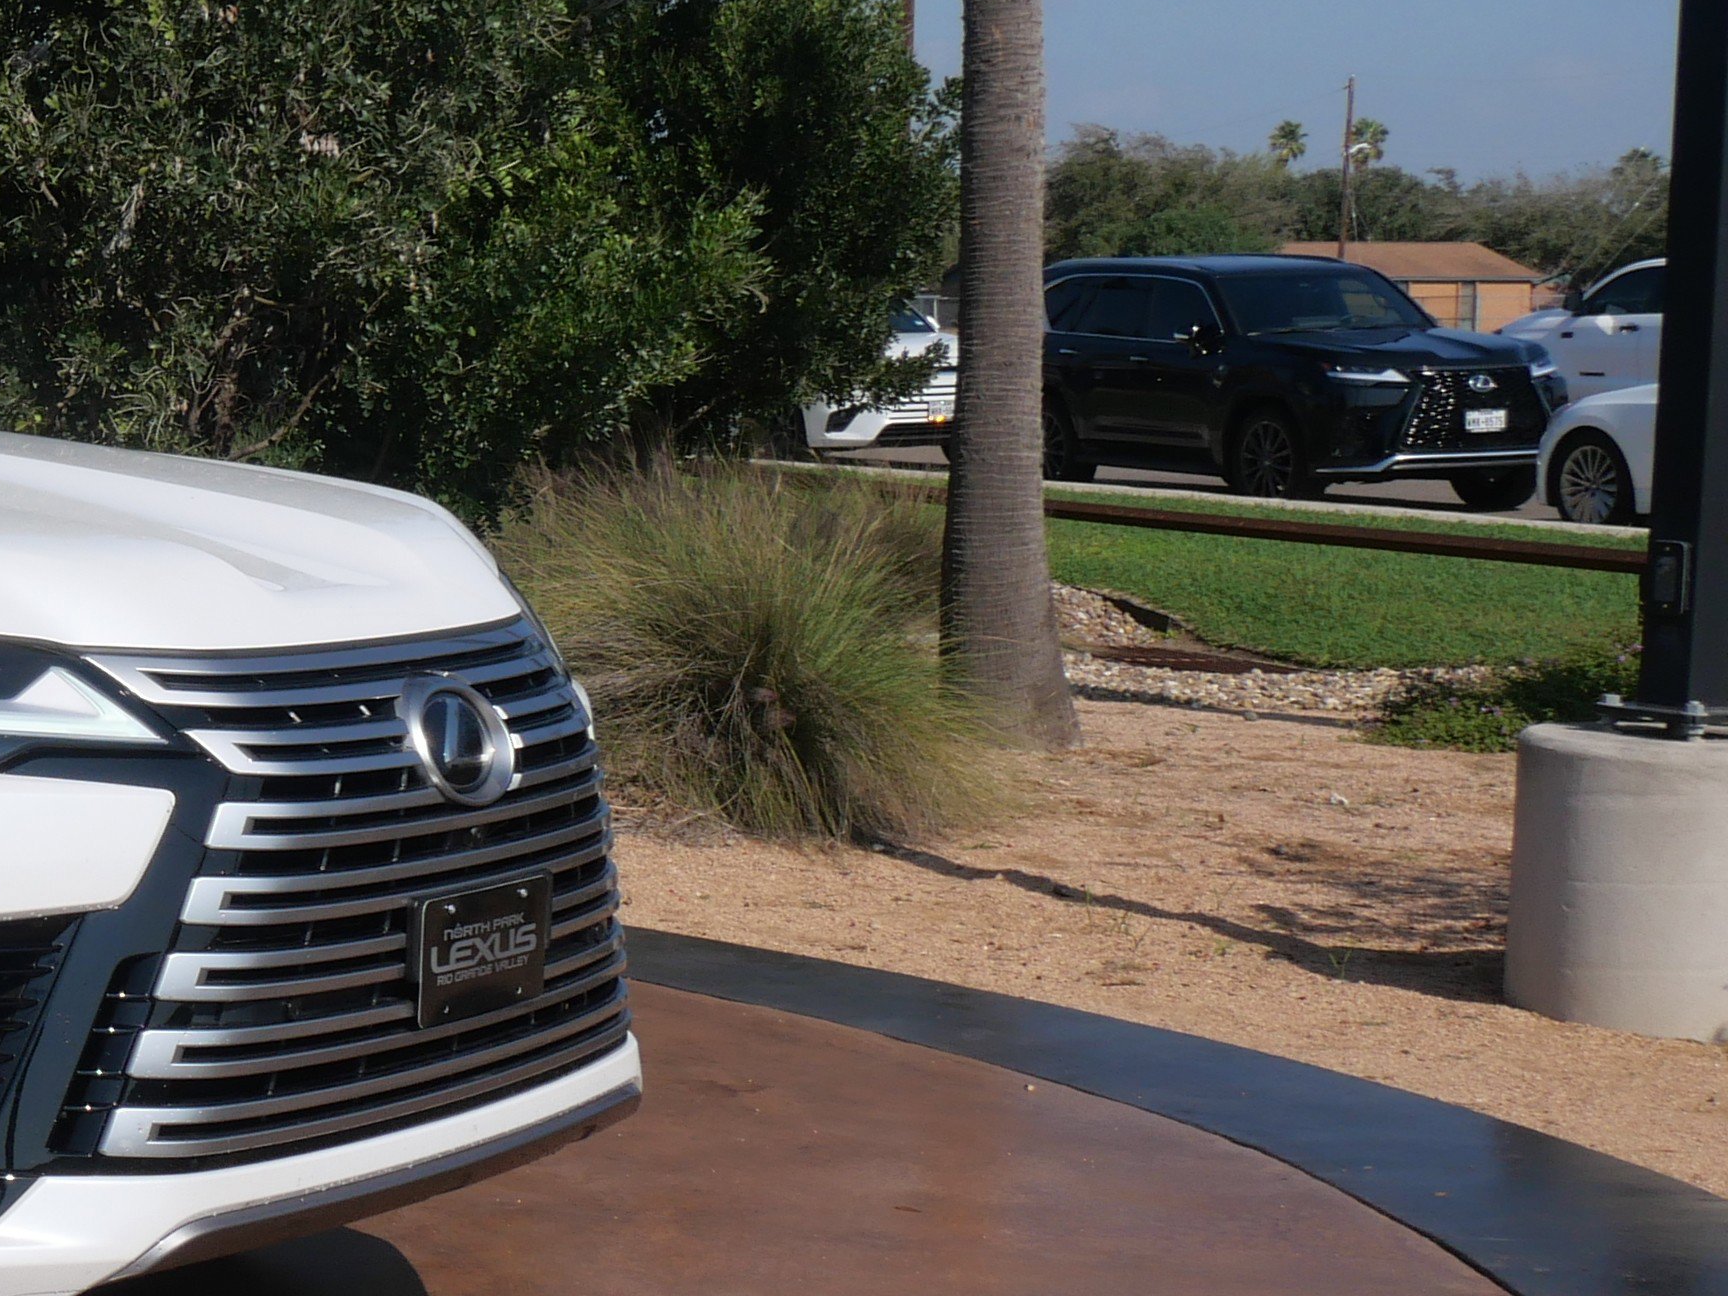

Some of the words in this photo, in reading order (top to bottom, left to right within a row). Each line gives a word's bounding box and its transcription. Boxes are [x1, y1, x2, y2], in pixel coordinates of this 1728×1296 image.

[444, 921, 490, 941] NORTH
[492, 912, 525, 930] PARK
[430, 923, 537, 974] LEXUS
[437, 973, 453, 986] RIO
[454, 964, 493, 982] GRANDE
[495, 954, 529, 973] VALLEY
